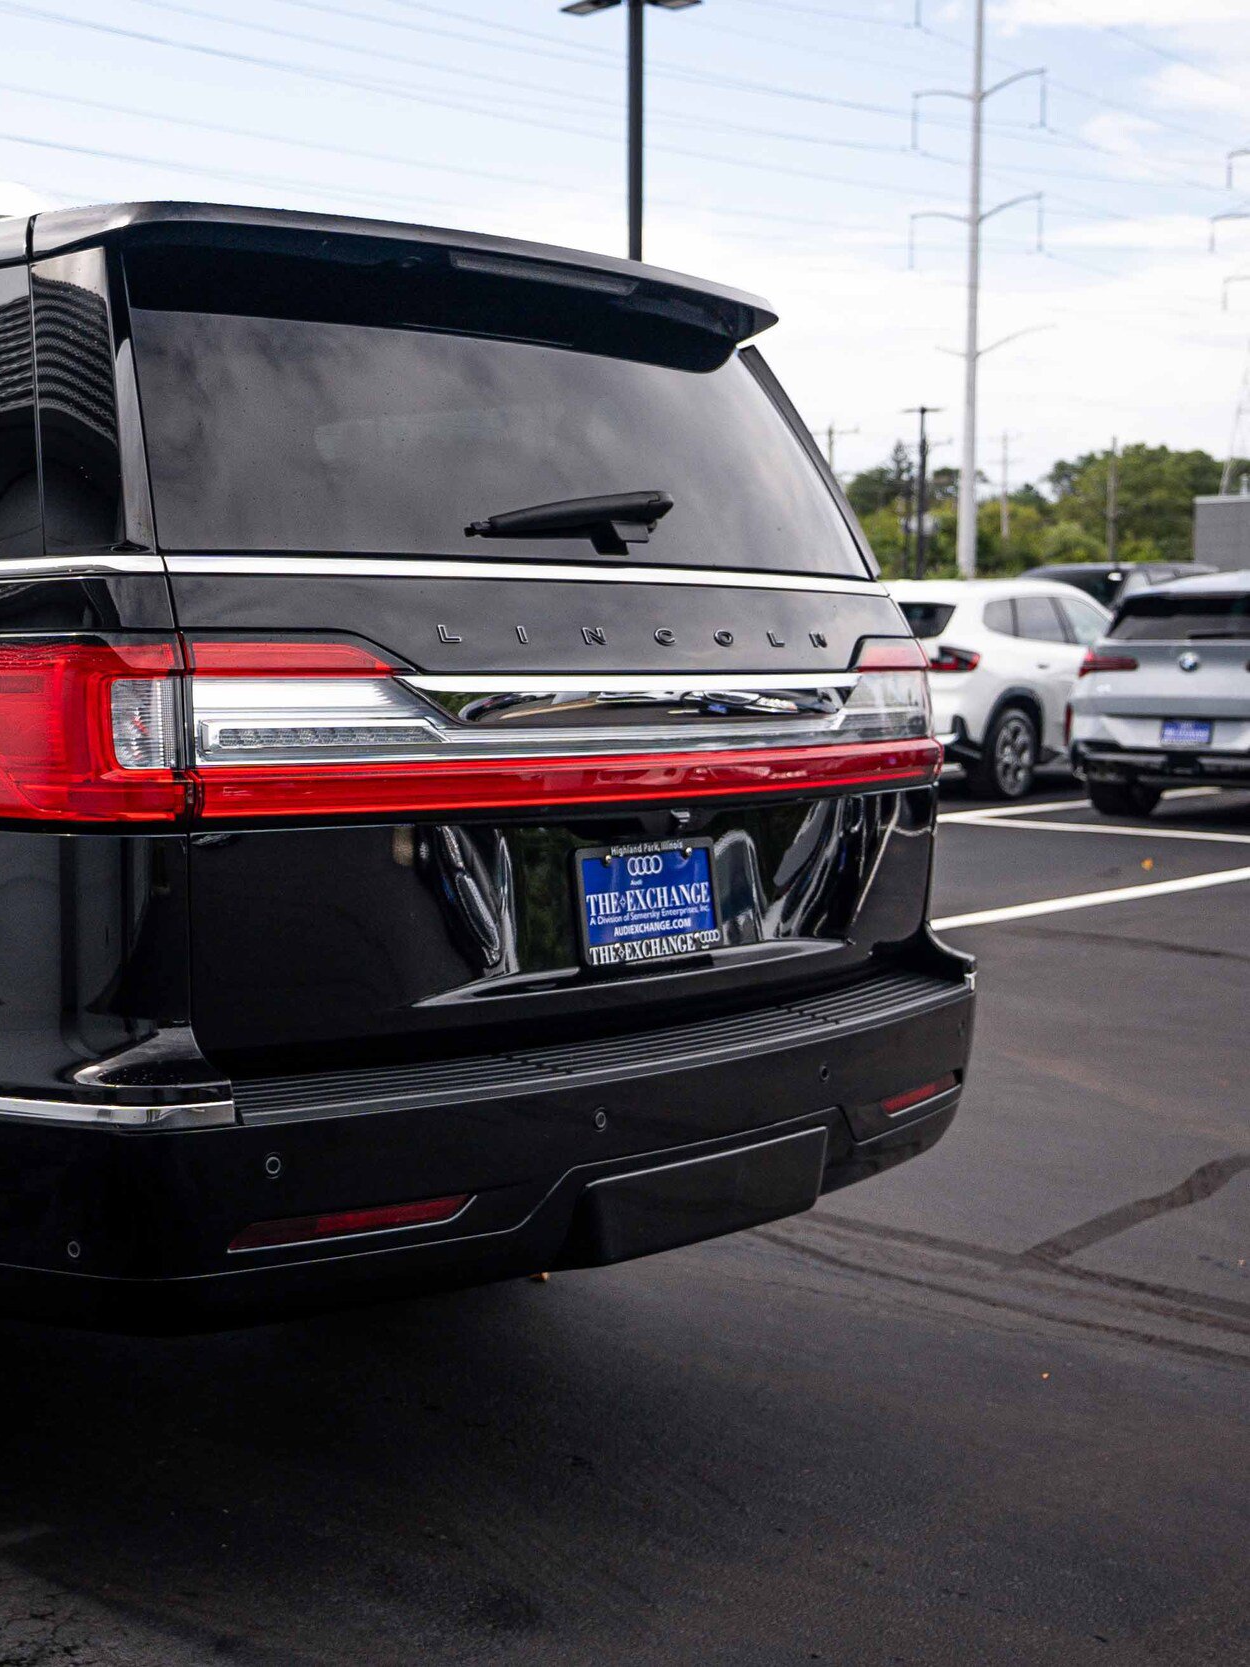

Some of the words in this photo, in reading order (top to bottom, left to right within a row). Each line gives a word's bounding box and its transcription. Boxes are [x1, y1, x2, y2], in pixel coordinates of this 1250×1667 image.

[437, 623, 828, 649] LINCOLN
[611, 844, 642, 856] Highland
[643, 843, 661, 852] Park,
[661, 840, 683, 850] Illinois
[586, 892, 621, 916] THE
[625, 882, 710, 912] EXCHANGE
[590, 917, 597, 925] A
[597, 915, 623, 925] Division
[623, 913, 631, 922] of
[614, 918, 691, 937] AUDIEXCHANGE.COM
[589, 945, 620, 966] THE
[624, 933, 696, 961] EXCHANGE
